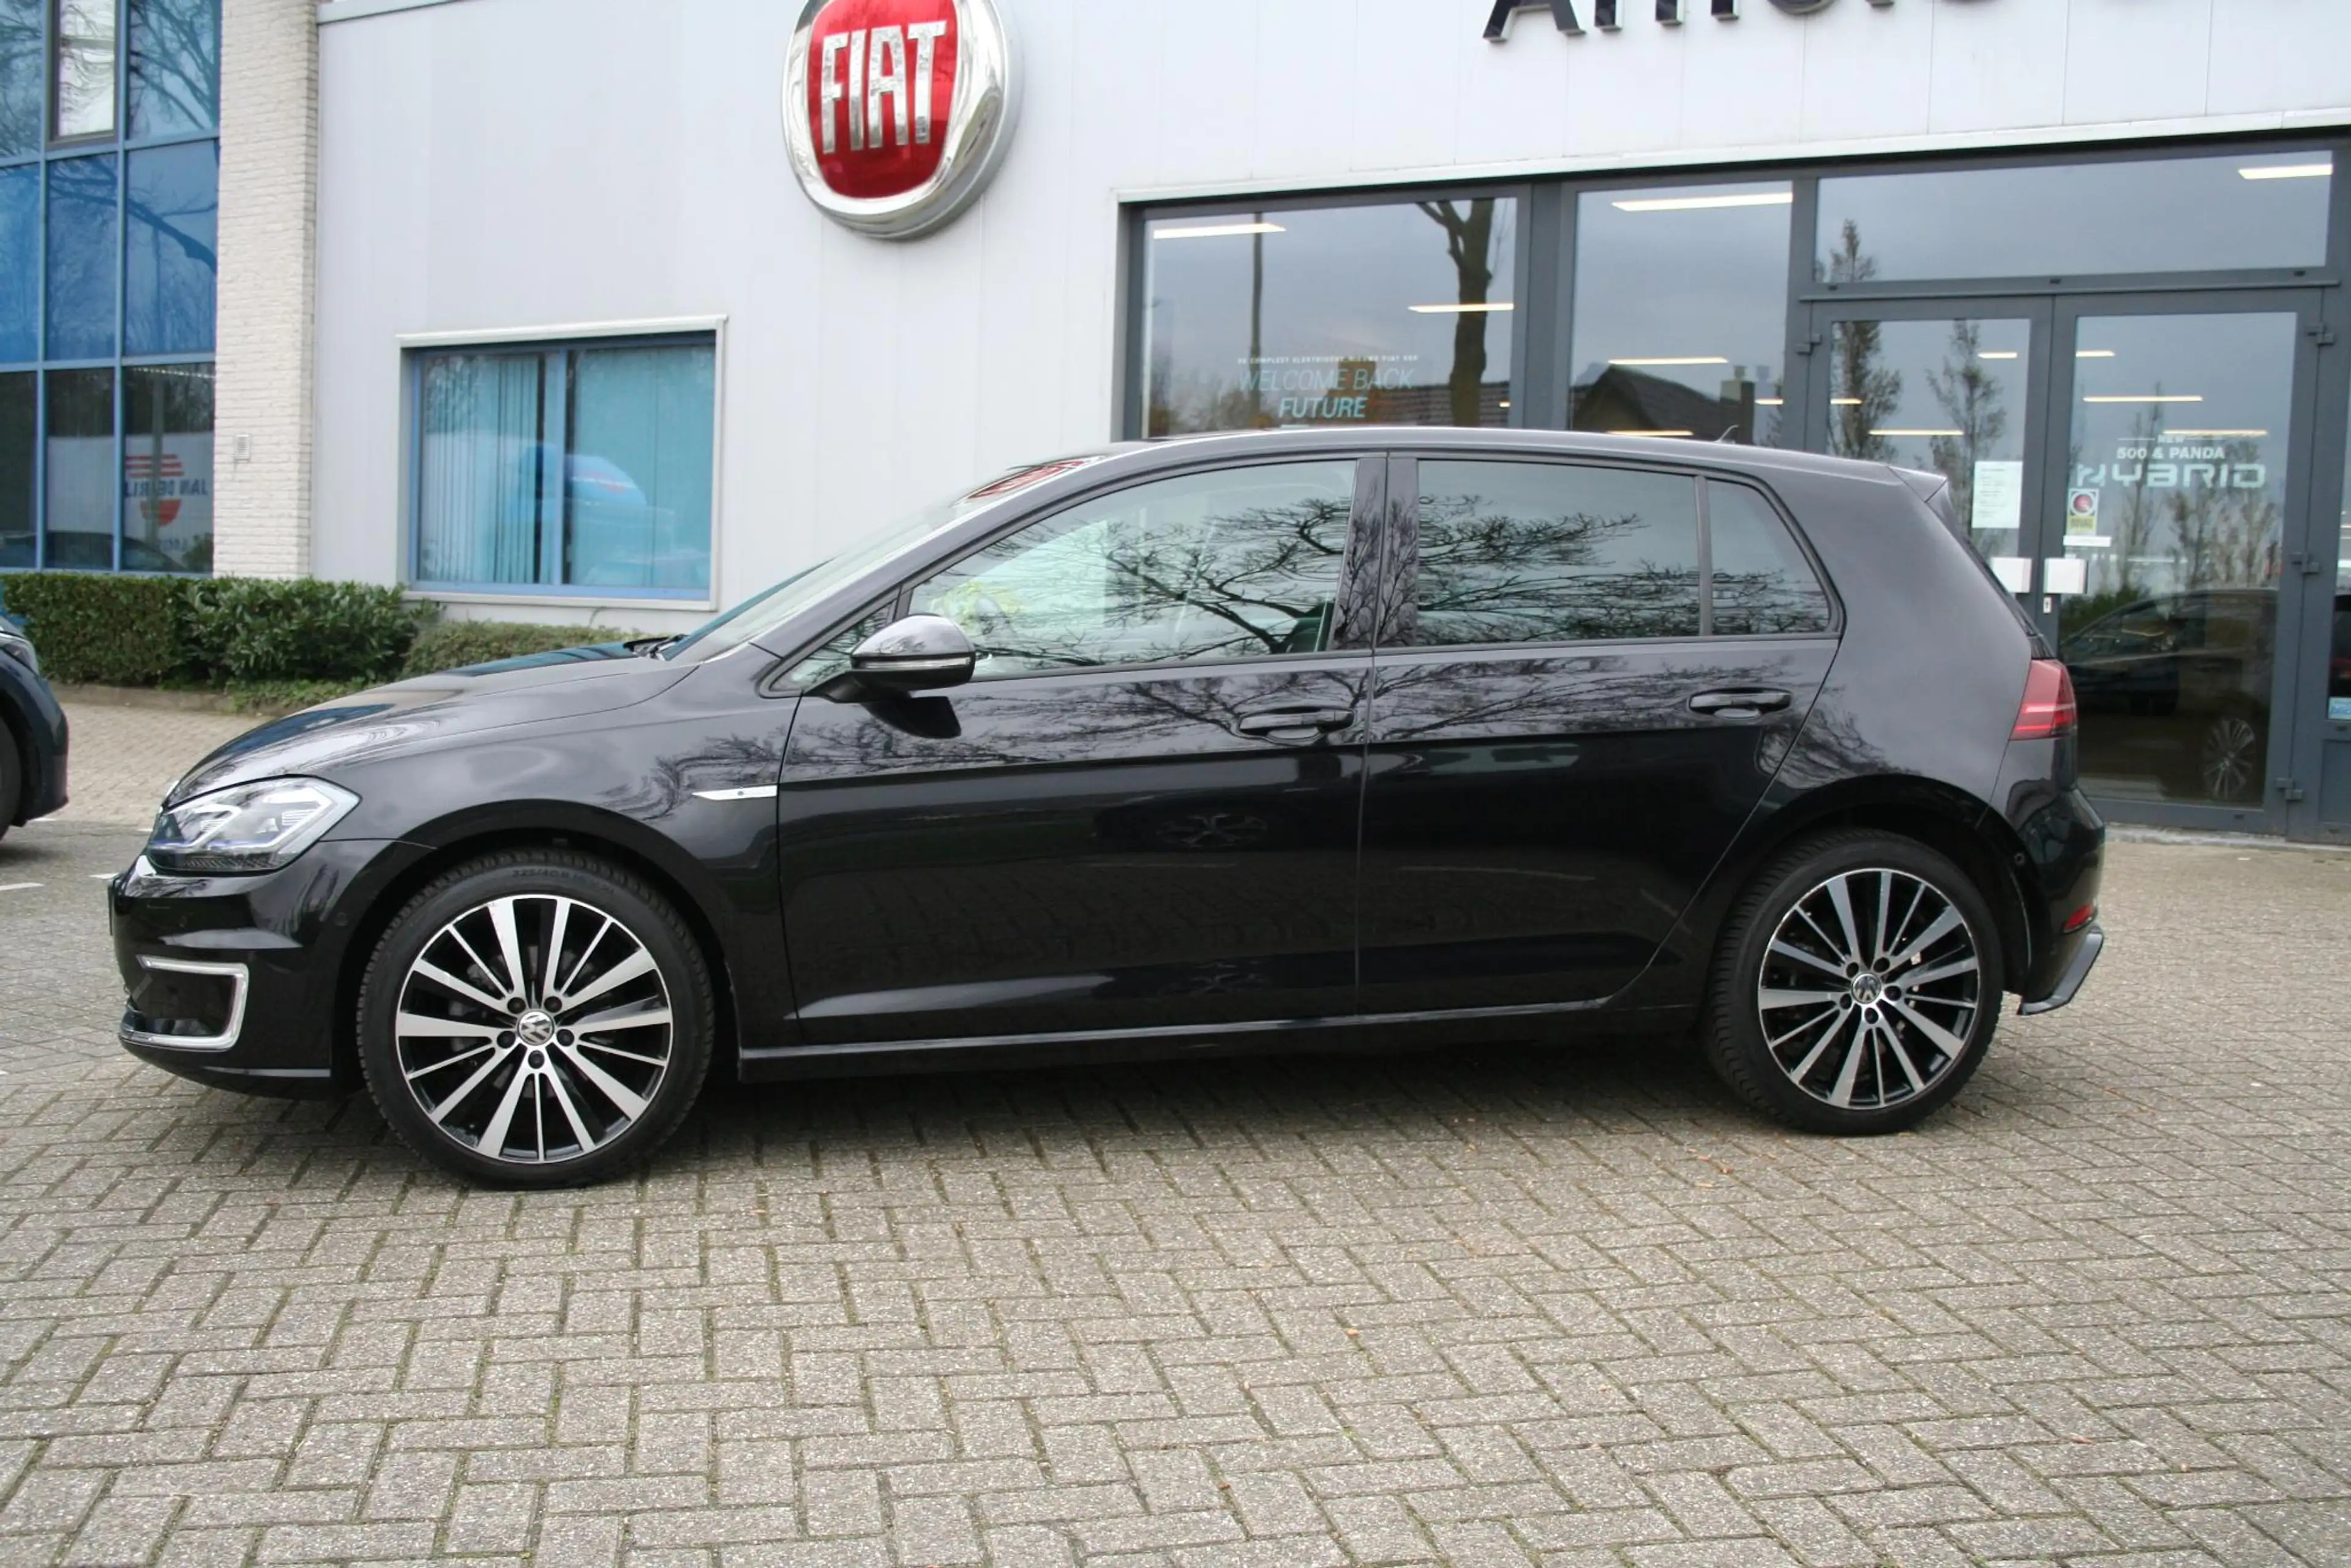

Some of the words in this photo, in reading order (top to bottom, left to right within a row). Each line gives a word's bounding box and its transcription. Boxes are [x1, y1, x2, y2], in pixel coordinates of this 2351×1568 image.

[821, 20, 947, 154] FIAT
[1239, 368, 1349, 391] WELCOME
[1353, 367, 1416, 390] BACK
[1278, 397, 1369, 418] FUTURE
[2116, 447, 2147, 459] 500
[2152, 446, 2164, 459] &
[2169, 446, 2226, 459] PANDA
